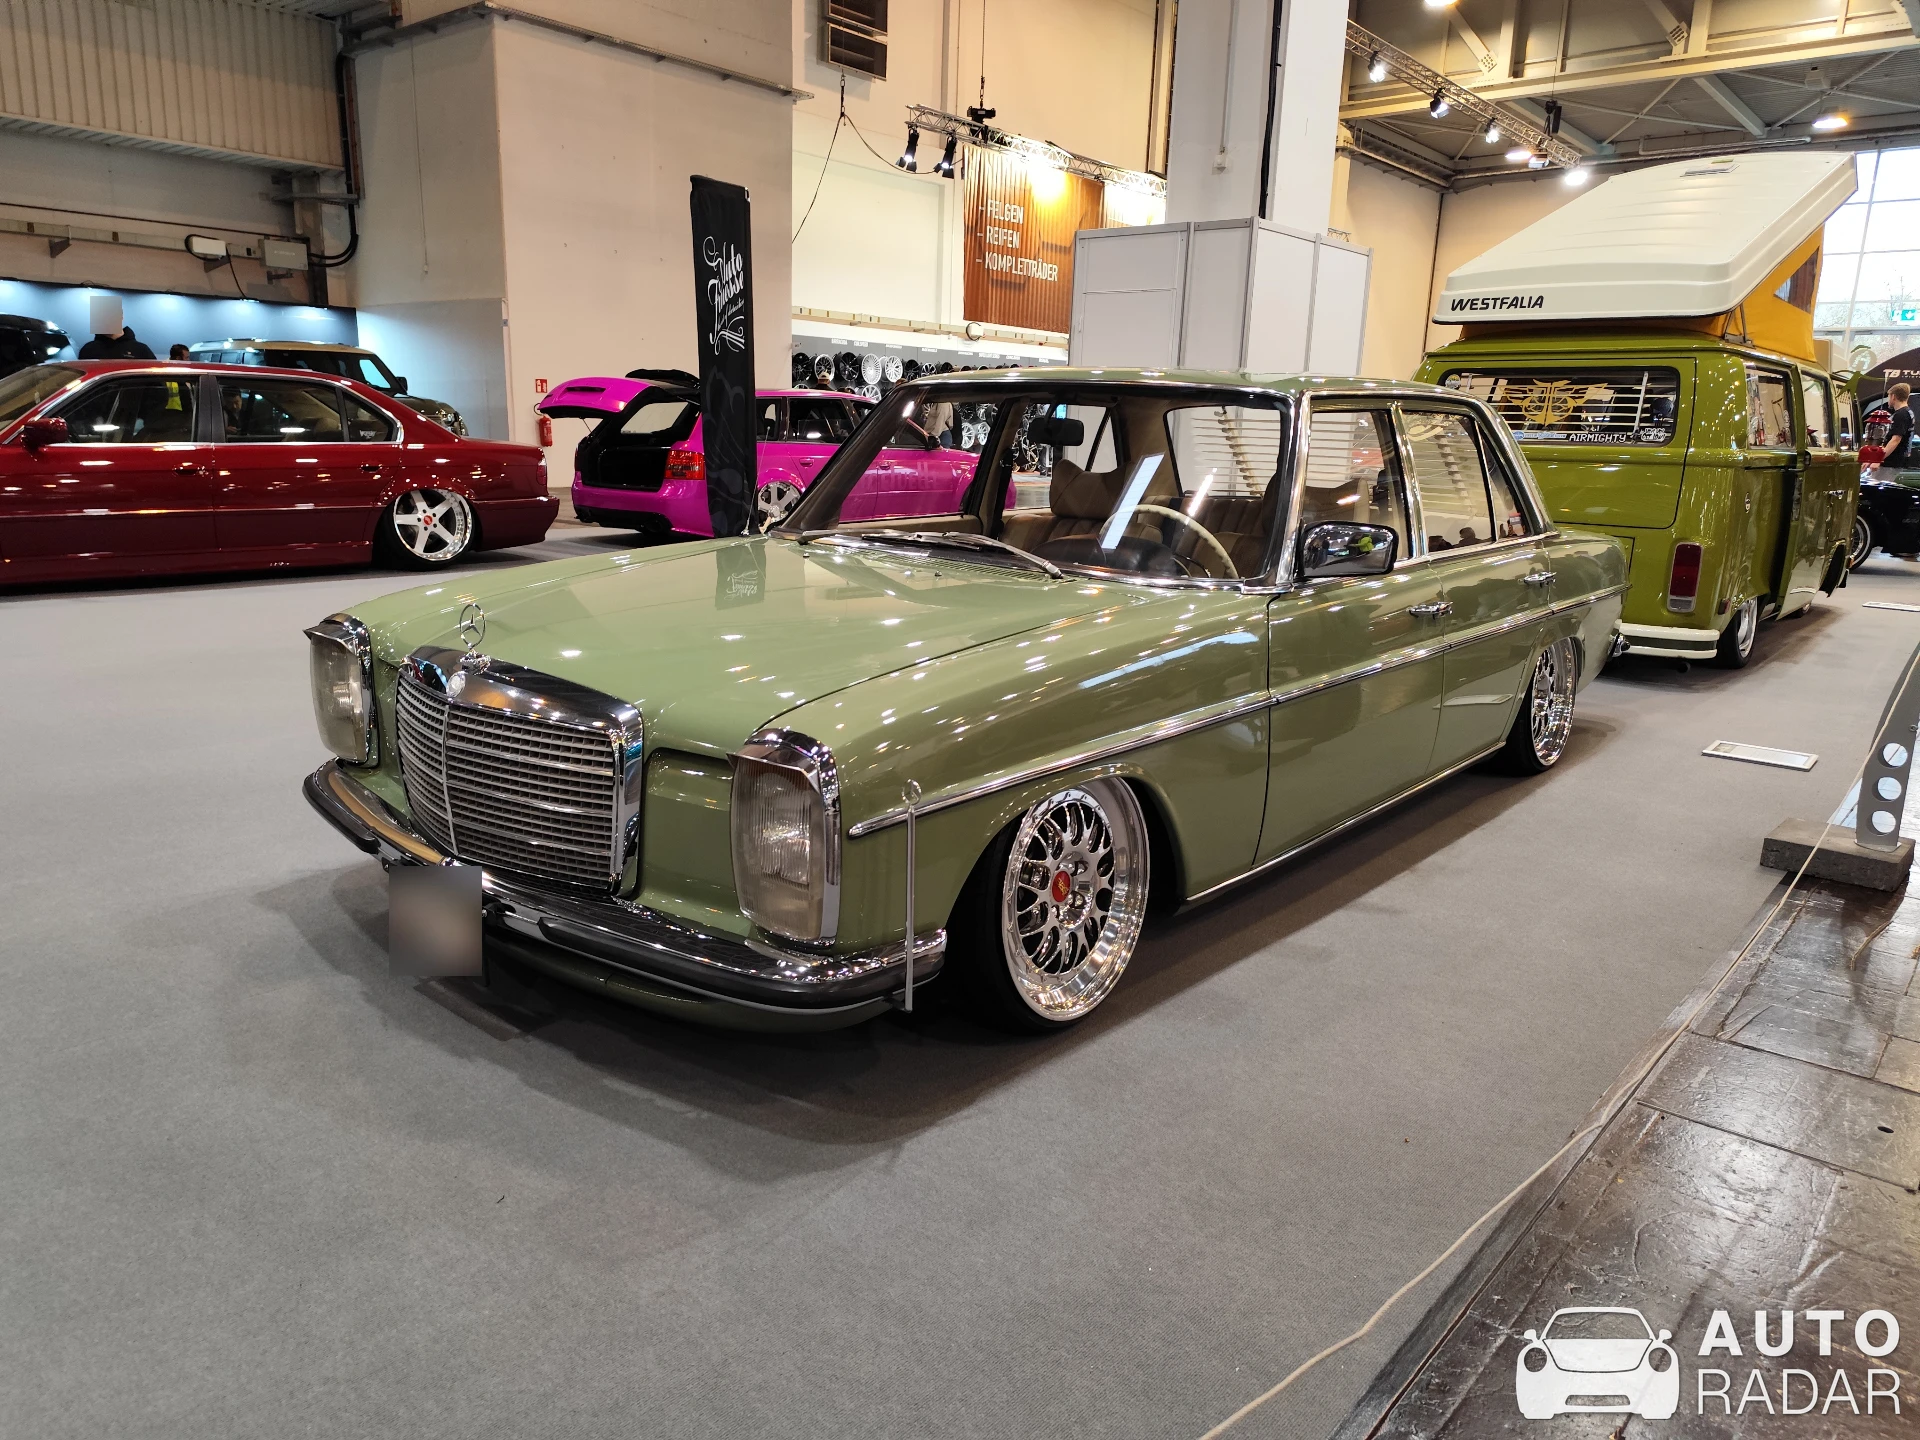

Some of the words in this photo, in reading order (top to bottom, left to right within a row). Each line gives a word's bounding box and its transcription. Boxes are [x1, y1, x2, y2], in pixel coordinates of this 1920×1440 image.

[986, 200, 1025, 225] FELGEN
[985, 225, 1021, 249] REIFEN
[984, 251, 1059, 282] KOMPLETTRÄDER
[1450, 295, 1545, 312] WESTFALIA
[1568, 433, 1627, 444] AIRMIGHTY
